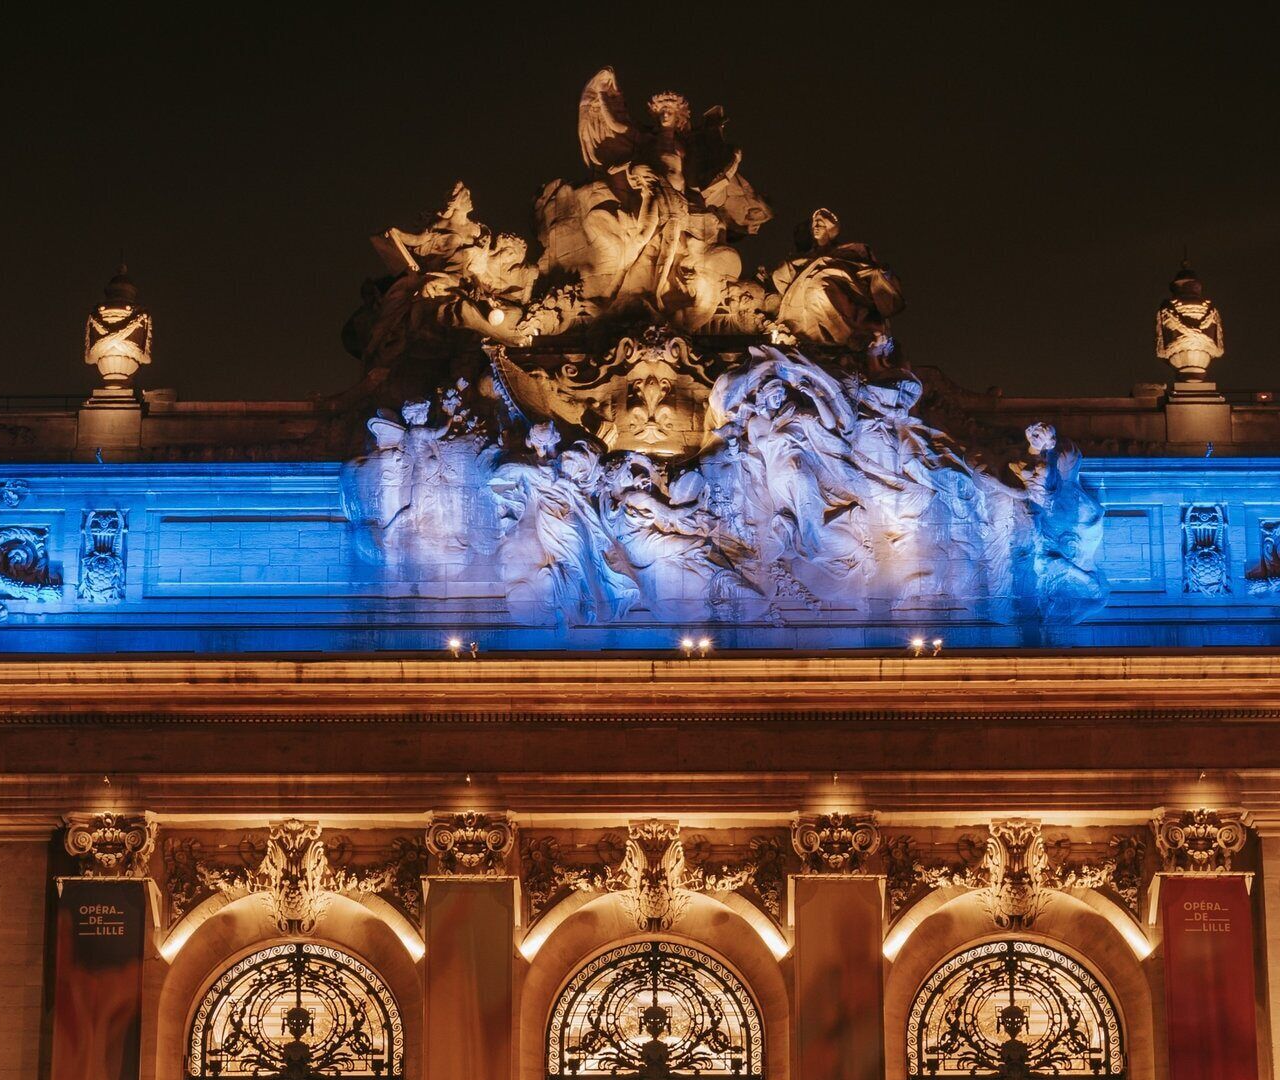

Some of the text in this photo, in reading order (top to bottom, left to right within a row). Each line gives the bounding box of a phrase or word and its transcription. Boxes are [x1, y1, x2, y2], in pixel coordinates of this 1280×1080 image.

[80, 904, 116, 915] OPÉRA
[1184, 900, 1221, 911] OPÉRA
[89, 916, 103, 925] DE
[1194, 912, 1209, 921] DE
[96, 926, 124, 936] LILLE
[1202, 923, 1231, 932] LILLE
